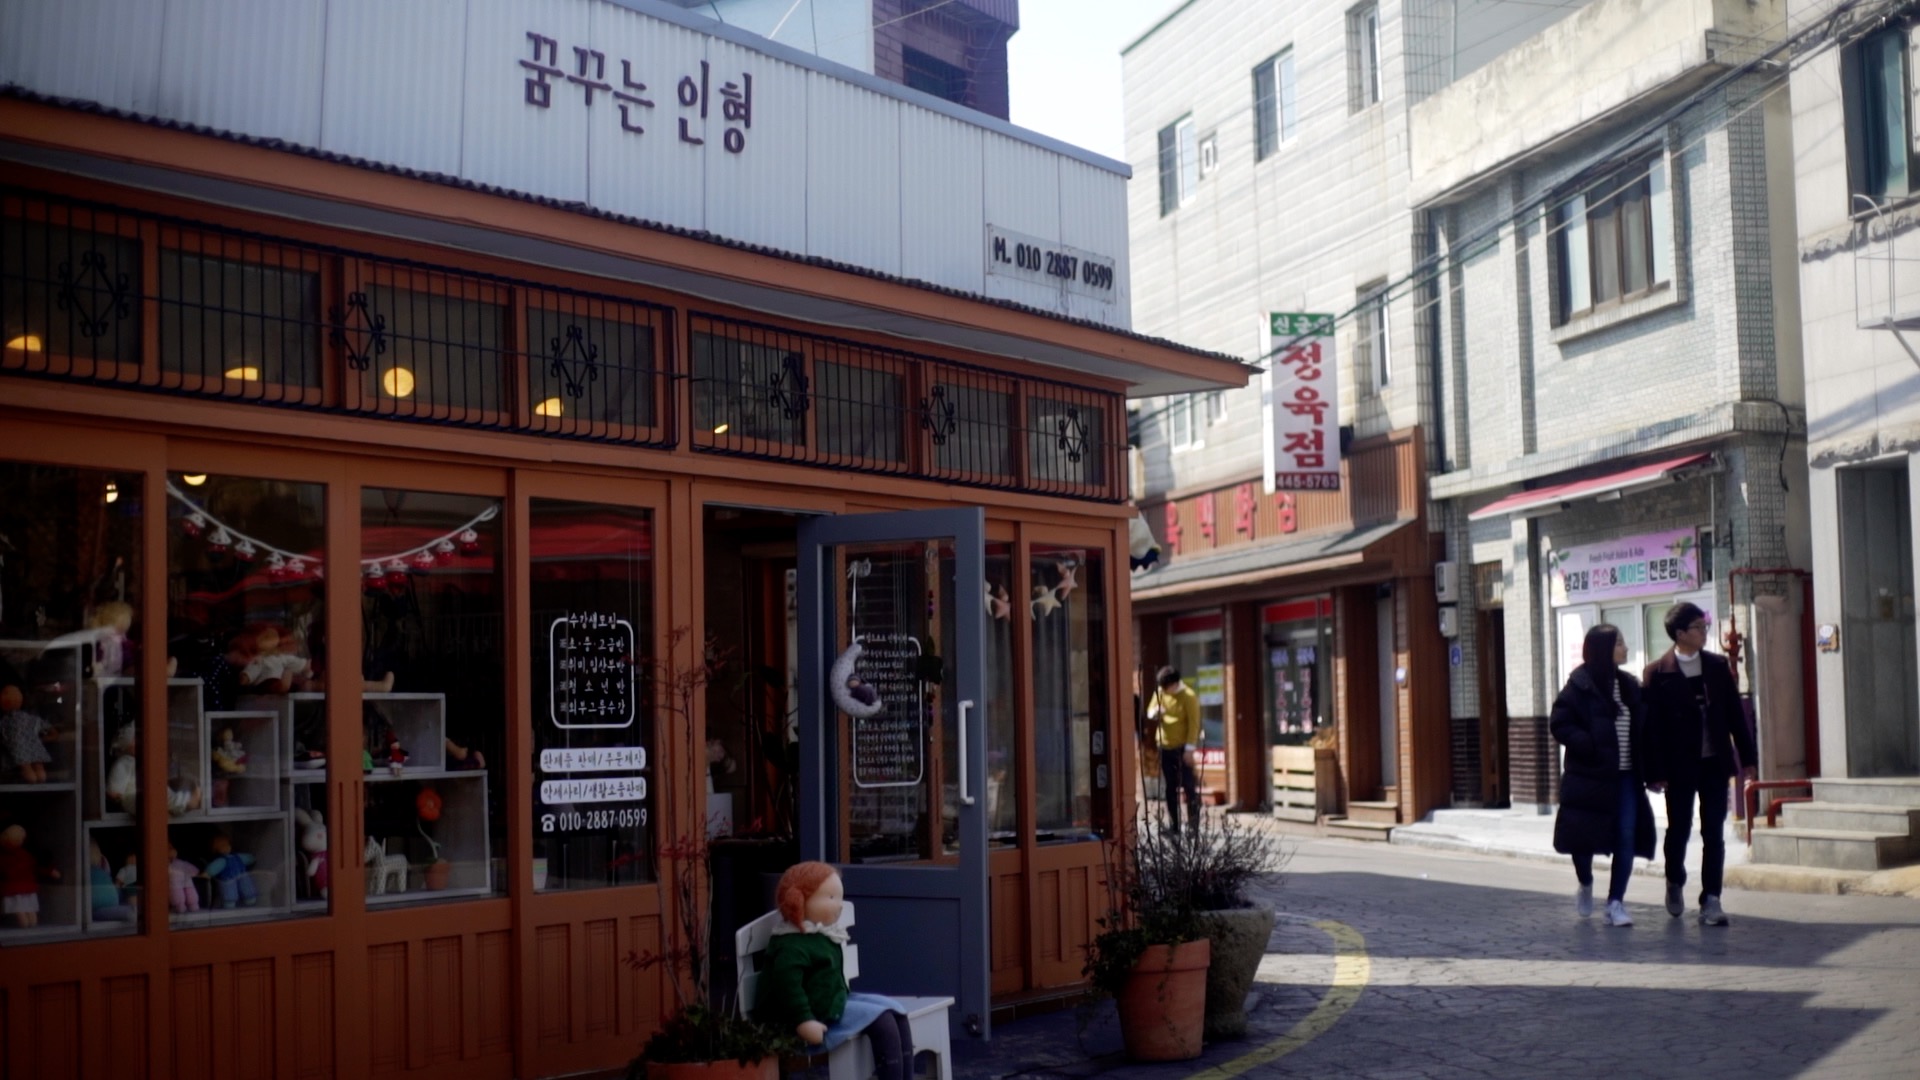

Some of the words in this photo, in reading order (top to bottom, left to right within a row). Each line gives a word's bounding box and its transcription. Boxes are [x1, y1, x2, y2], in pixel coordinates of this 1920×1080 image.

[520, 31, 655, 134] 꿈꾸는
[678, 59, 753, 154] 인형
[994, 235, 1012, 264] M.
[1016, 243, 1041, 271] 010
[1046, 251, 1078, 281] 2887
[1083, 260, 1113, 290] 0599
[1281, 342, 1329, 468] 정육점
[1276, 473, 1338, 489] 445-5763
[1649, 557, 1678, 581] 전문점
[569, 610, 617, 630] 수강생모집
[544, 752, 573, 769] 완제품
[559, 808, 648, 832] 010-2887-0599
